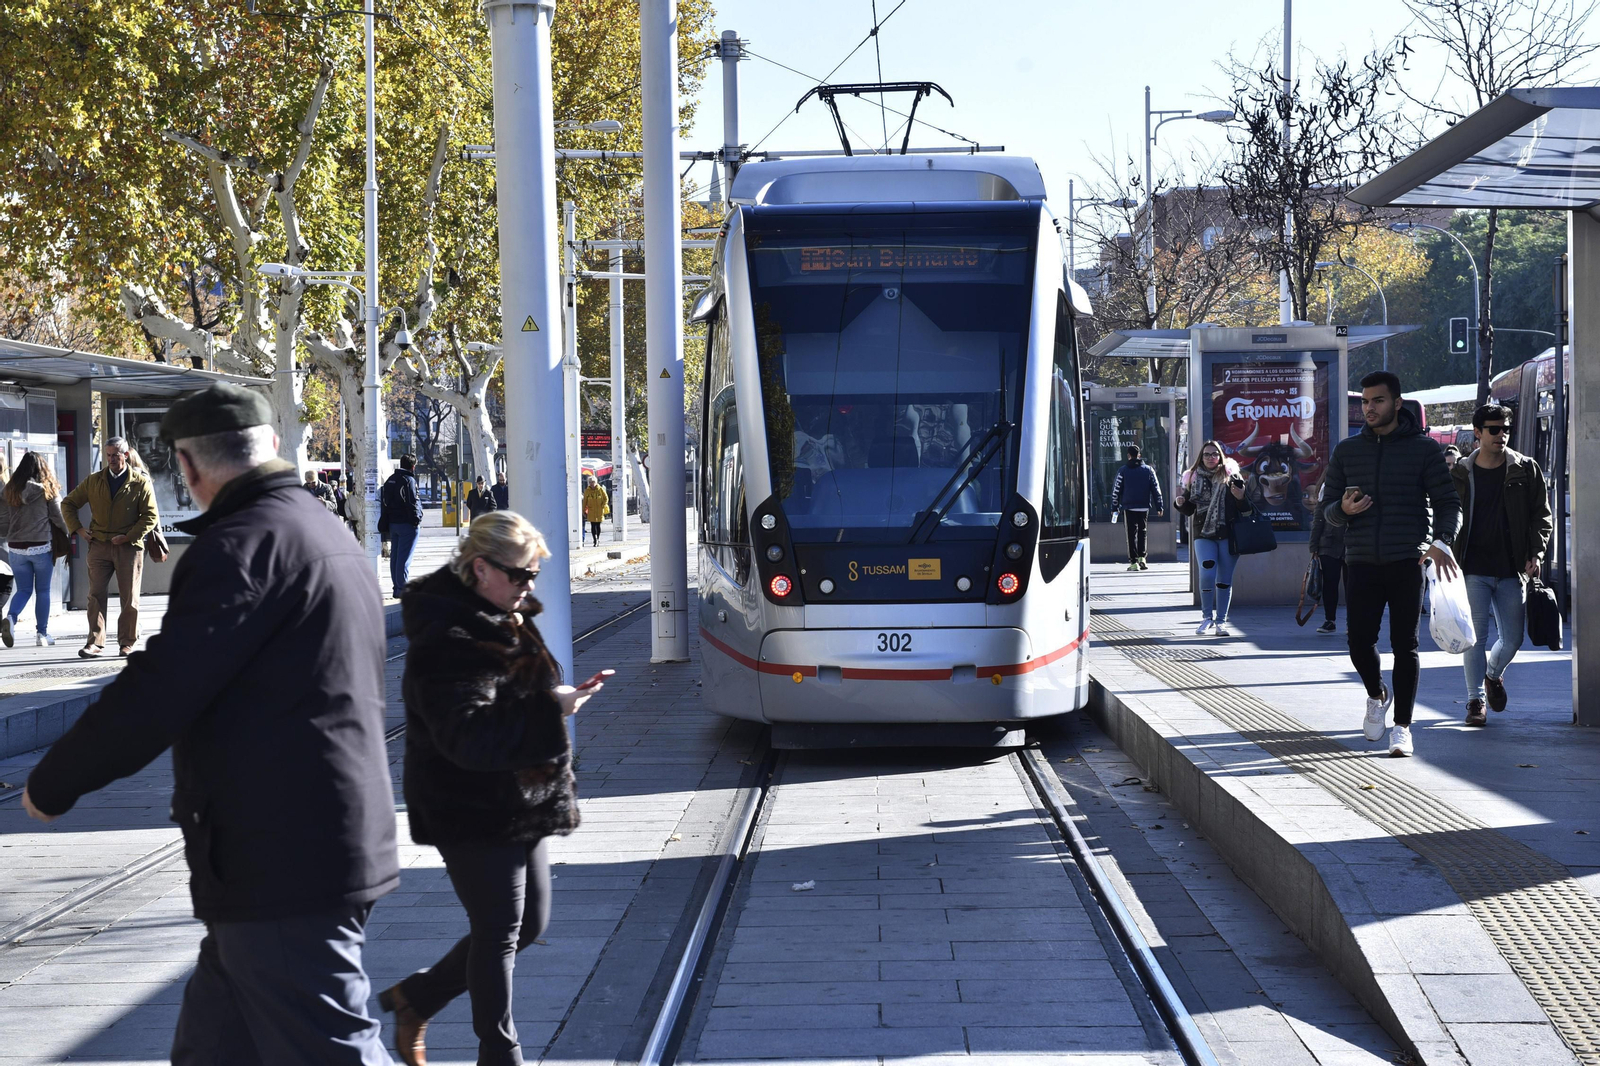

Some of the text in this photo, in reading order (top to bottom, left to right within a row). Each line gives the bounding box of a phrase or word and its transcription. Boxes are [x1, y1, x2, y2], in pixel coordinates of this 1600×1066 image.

[1336, 327, 1347, 335] A2
[1225, 370, 1231, 383] 2
[1225, 396, 1317, 421] FERDINAND
[1112, 472, 1123, 506] OUTFIT
[862, 565, 906, 575] TUSSAM
[877, 632, 912, 652] 302
